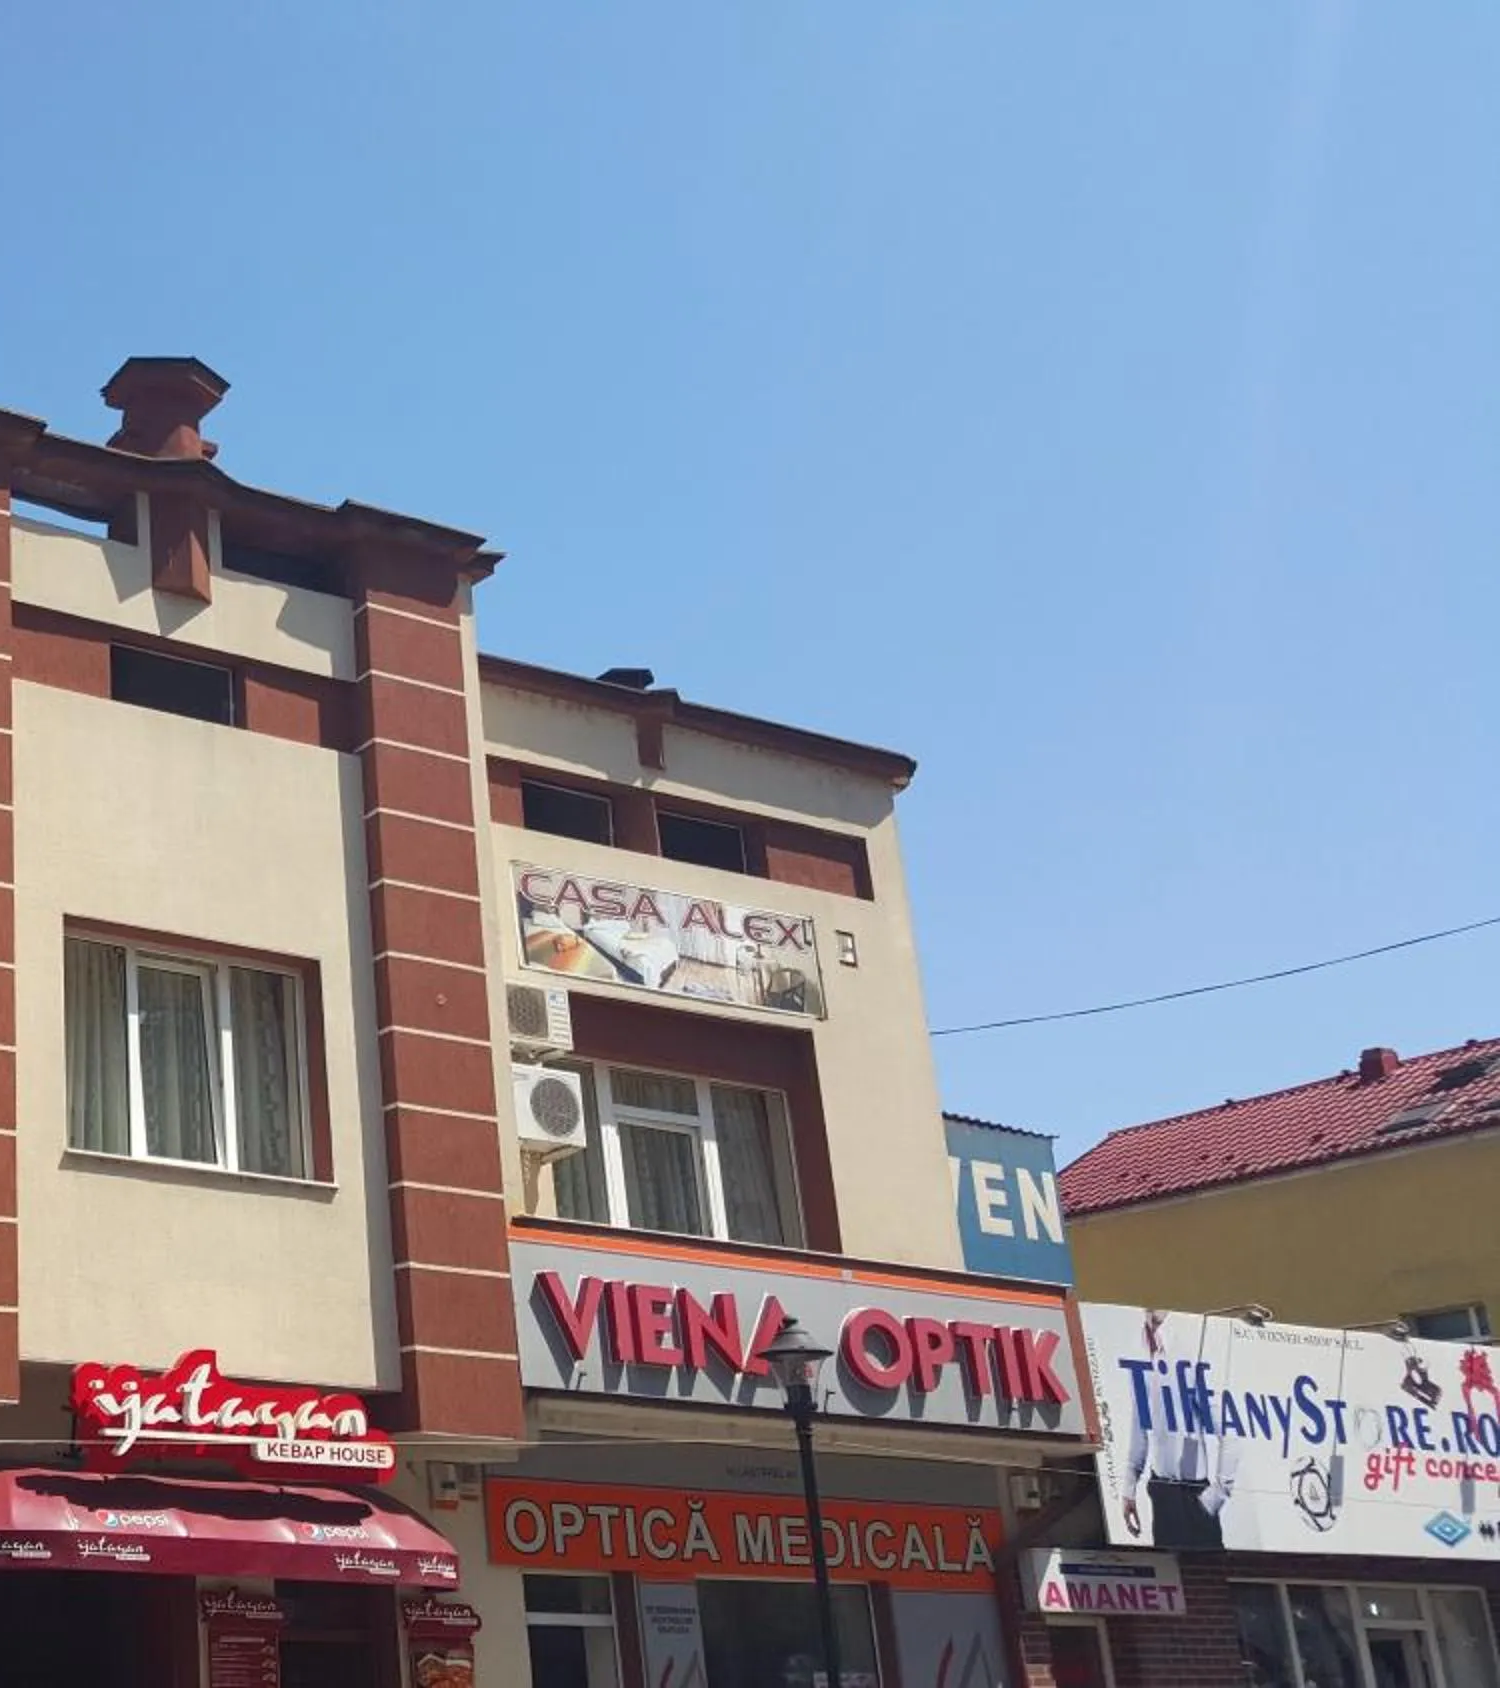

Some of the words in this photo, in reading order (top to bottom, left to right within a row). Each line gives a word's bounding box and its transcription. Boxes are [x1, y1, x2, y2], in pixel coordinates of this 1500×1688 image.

[519, 871, 668, 929] CASA
[681, 900, 805, 951] ALEX
[839, 1305, 1070, 1404] OPTIK
[267, 1443, 325, 1459] KEBAP
[330, 1448, 387, 1464] HOUSE
[1364, 1443, 1416, 1492] gift
[119, 1513, 169, 1529] pepsi
[503, 1497, 721, 1564] OPTICĂ
[733, 1513, 996, 1573] MEDICALĂ
[1044, 1580, 1178, 1611] AMANET
